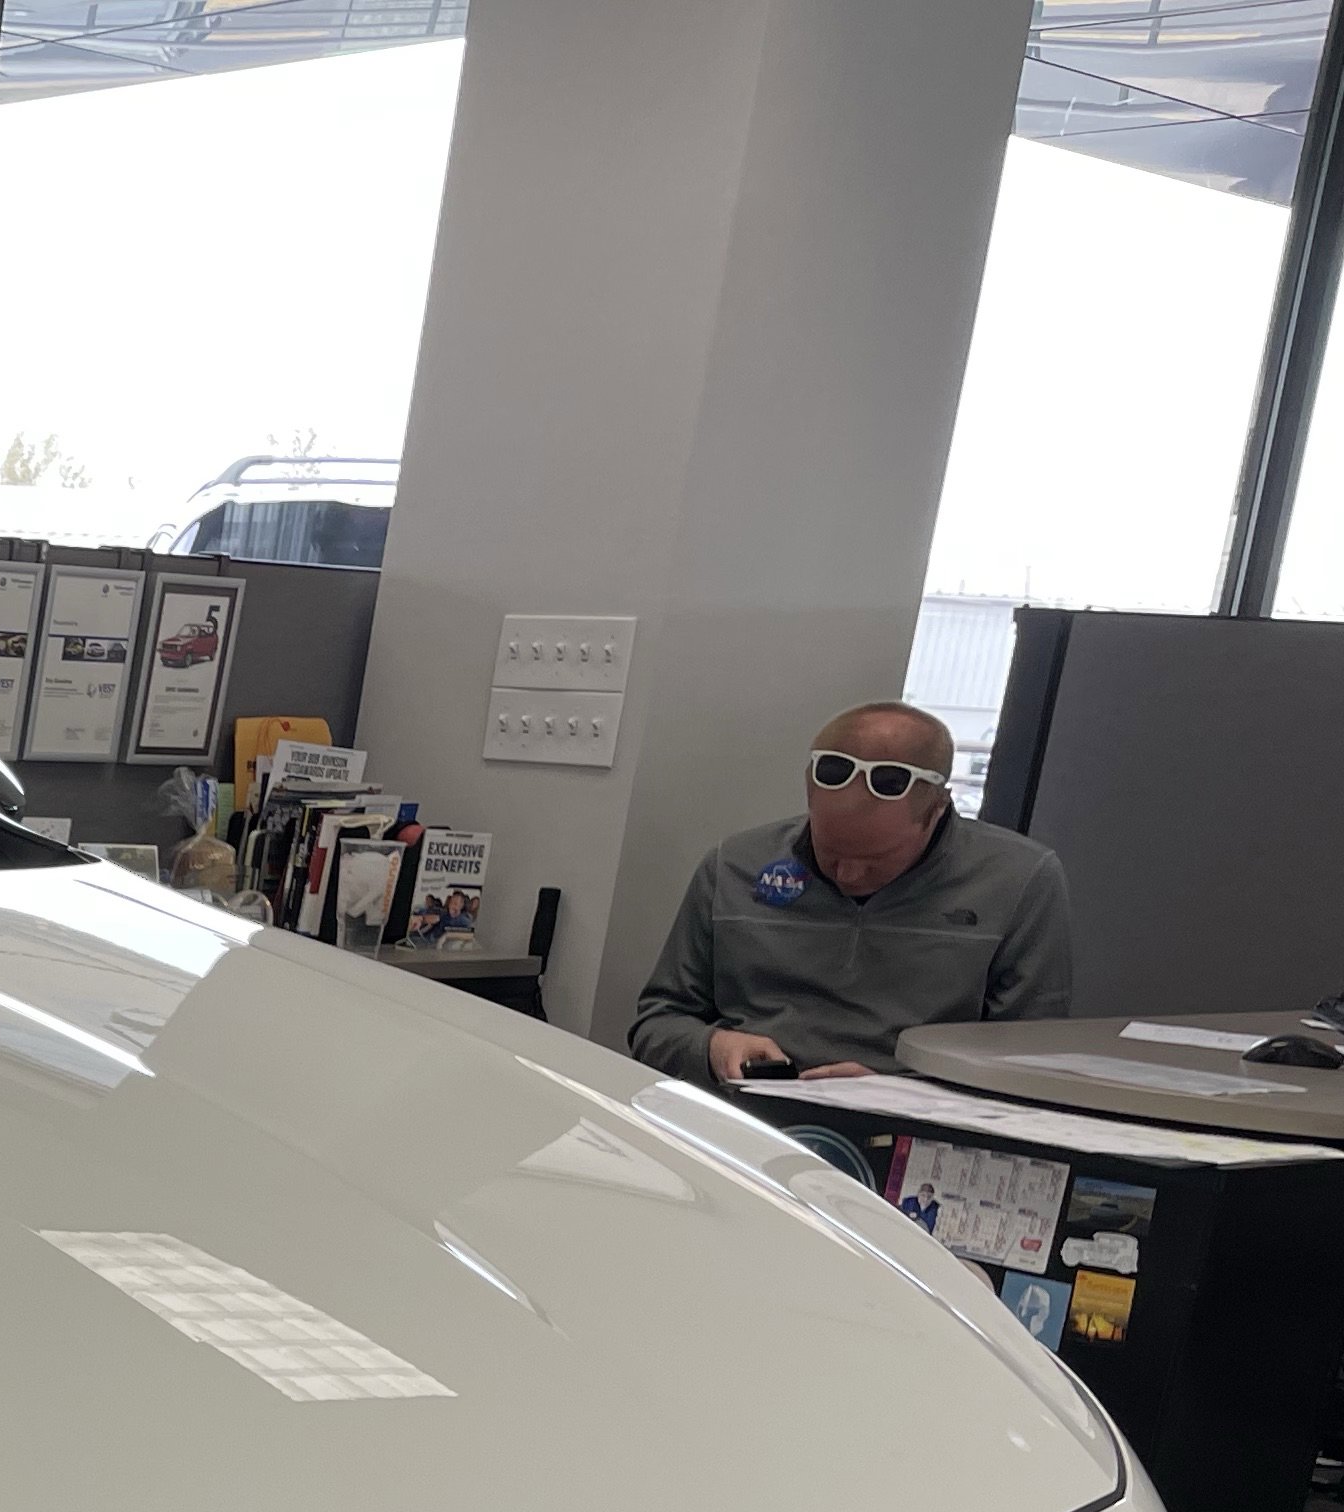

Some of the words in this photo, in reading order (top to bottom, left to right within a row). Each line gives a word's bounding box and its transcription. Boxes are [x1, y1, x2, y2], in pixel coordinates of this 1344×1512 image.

[427, 841, 485, 858] EXCLUSIVE
[424, 858, 481, 874] BENEFITS
[761, 872, 804, 890] NASA
